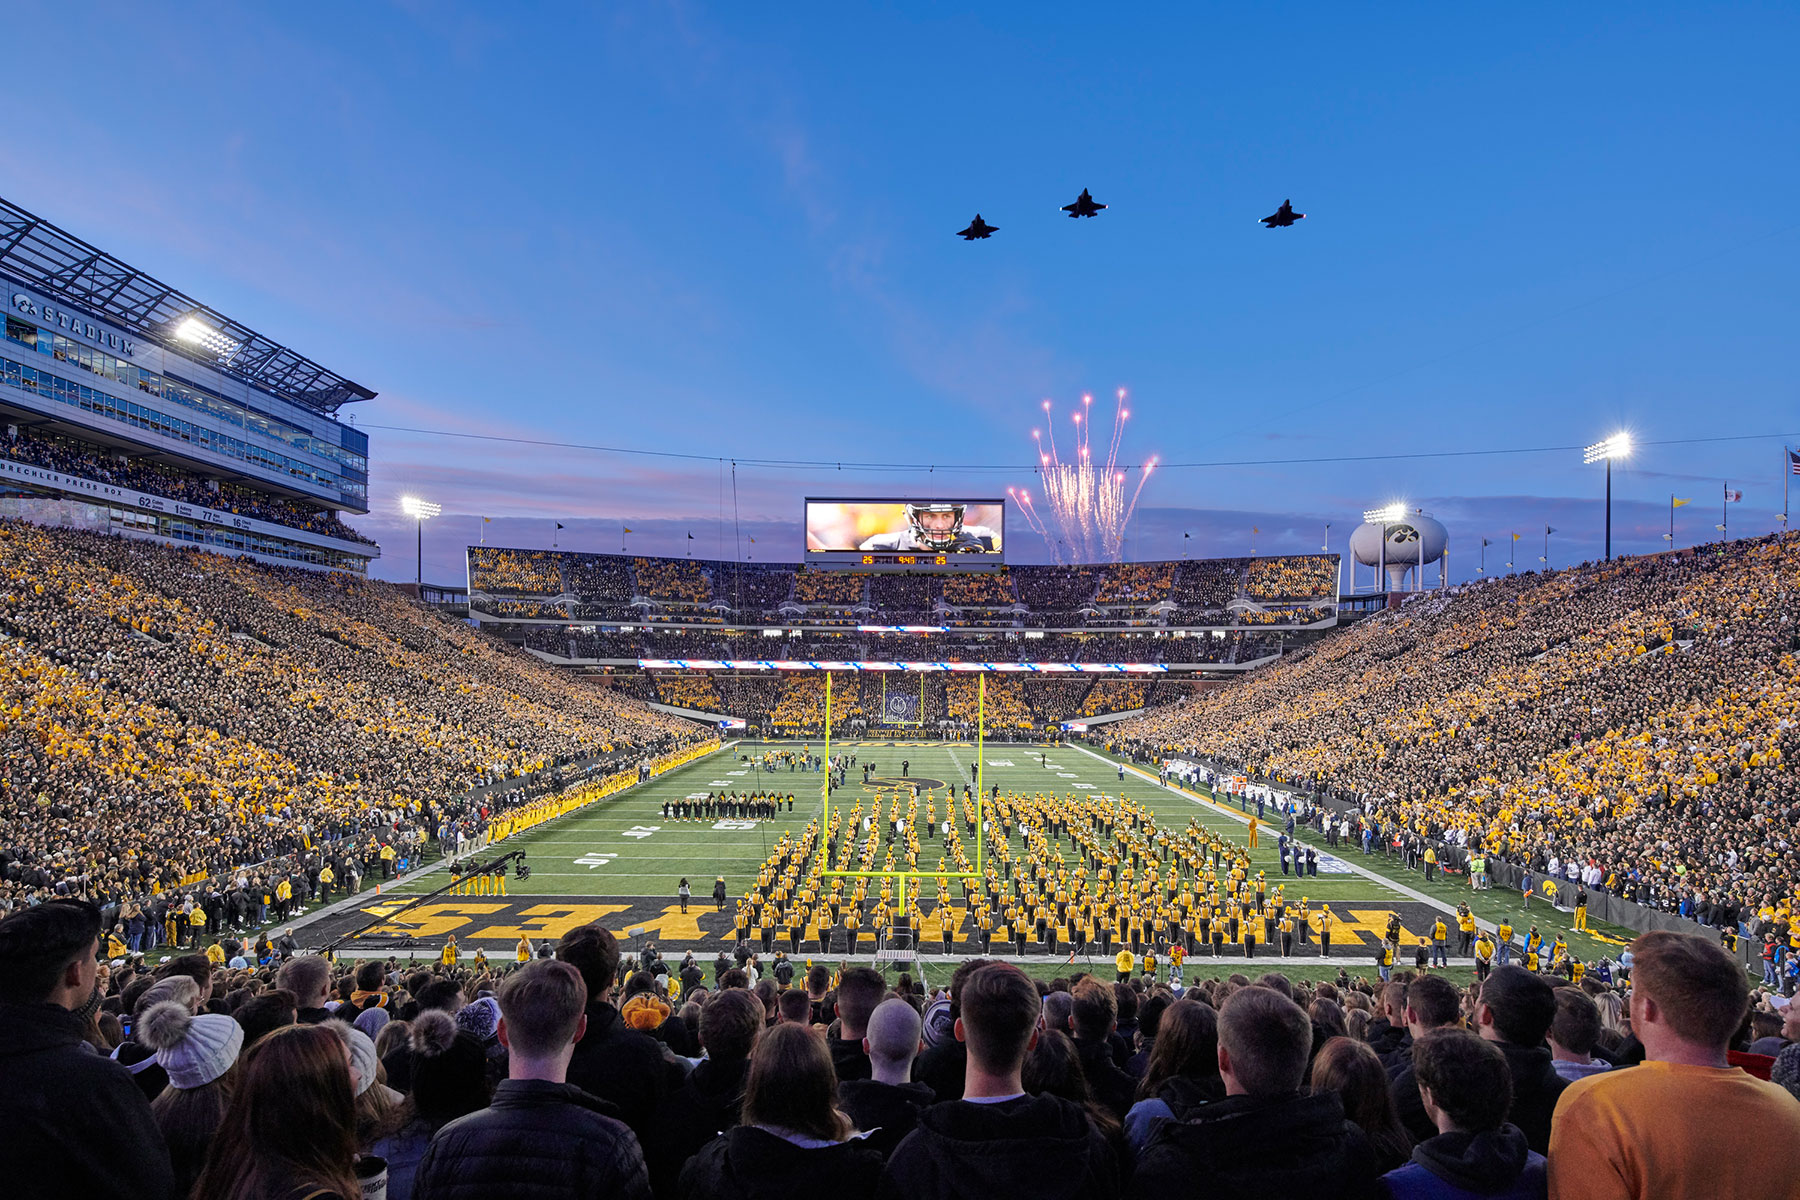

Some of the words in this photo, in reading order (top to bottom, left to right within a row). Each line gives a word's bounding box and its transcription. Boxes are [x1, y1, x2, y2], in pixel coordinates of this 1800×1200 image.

[43, 306, 135, 356] STADIUM
[1, 463, 59, 482] BRECHLER
[66, 478, 97, 491] PRESS
[104, 487, 122, 496] BOX
[139, 497, 151, 508] 62
[174, 504, 179, 514] 1
[202, 511, 213, 521] 77
[233, 517, 241, 528] 16
[862, 555, 874, 565] 25
[936, 556, 947, 565] 25
[573, 852, 618, 864] 10
